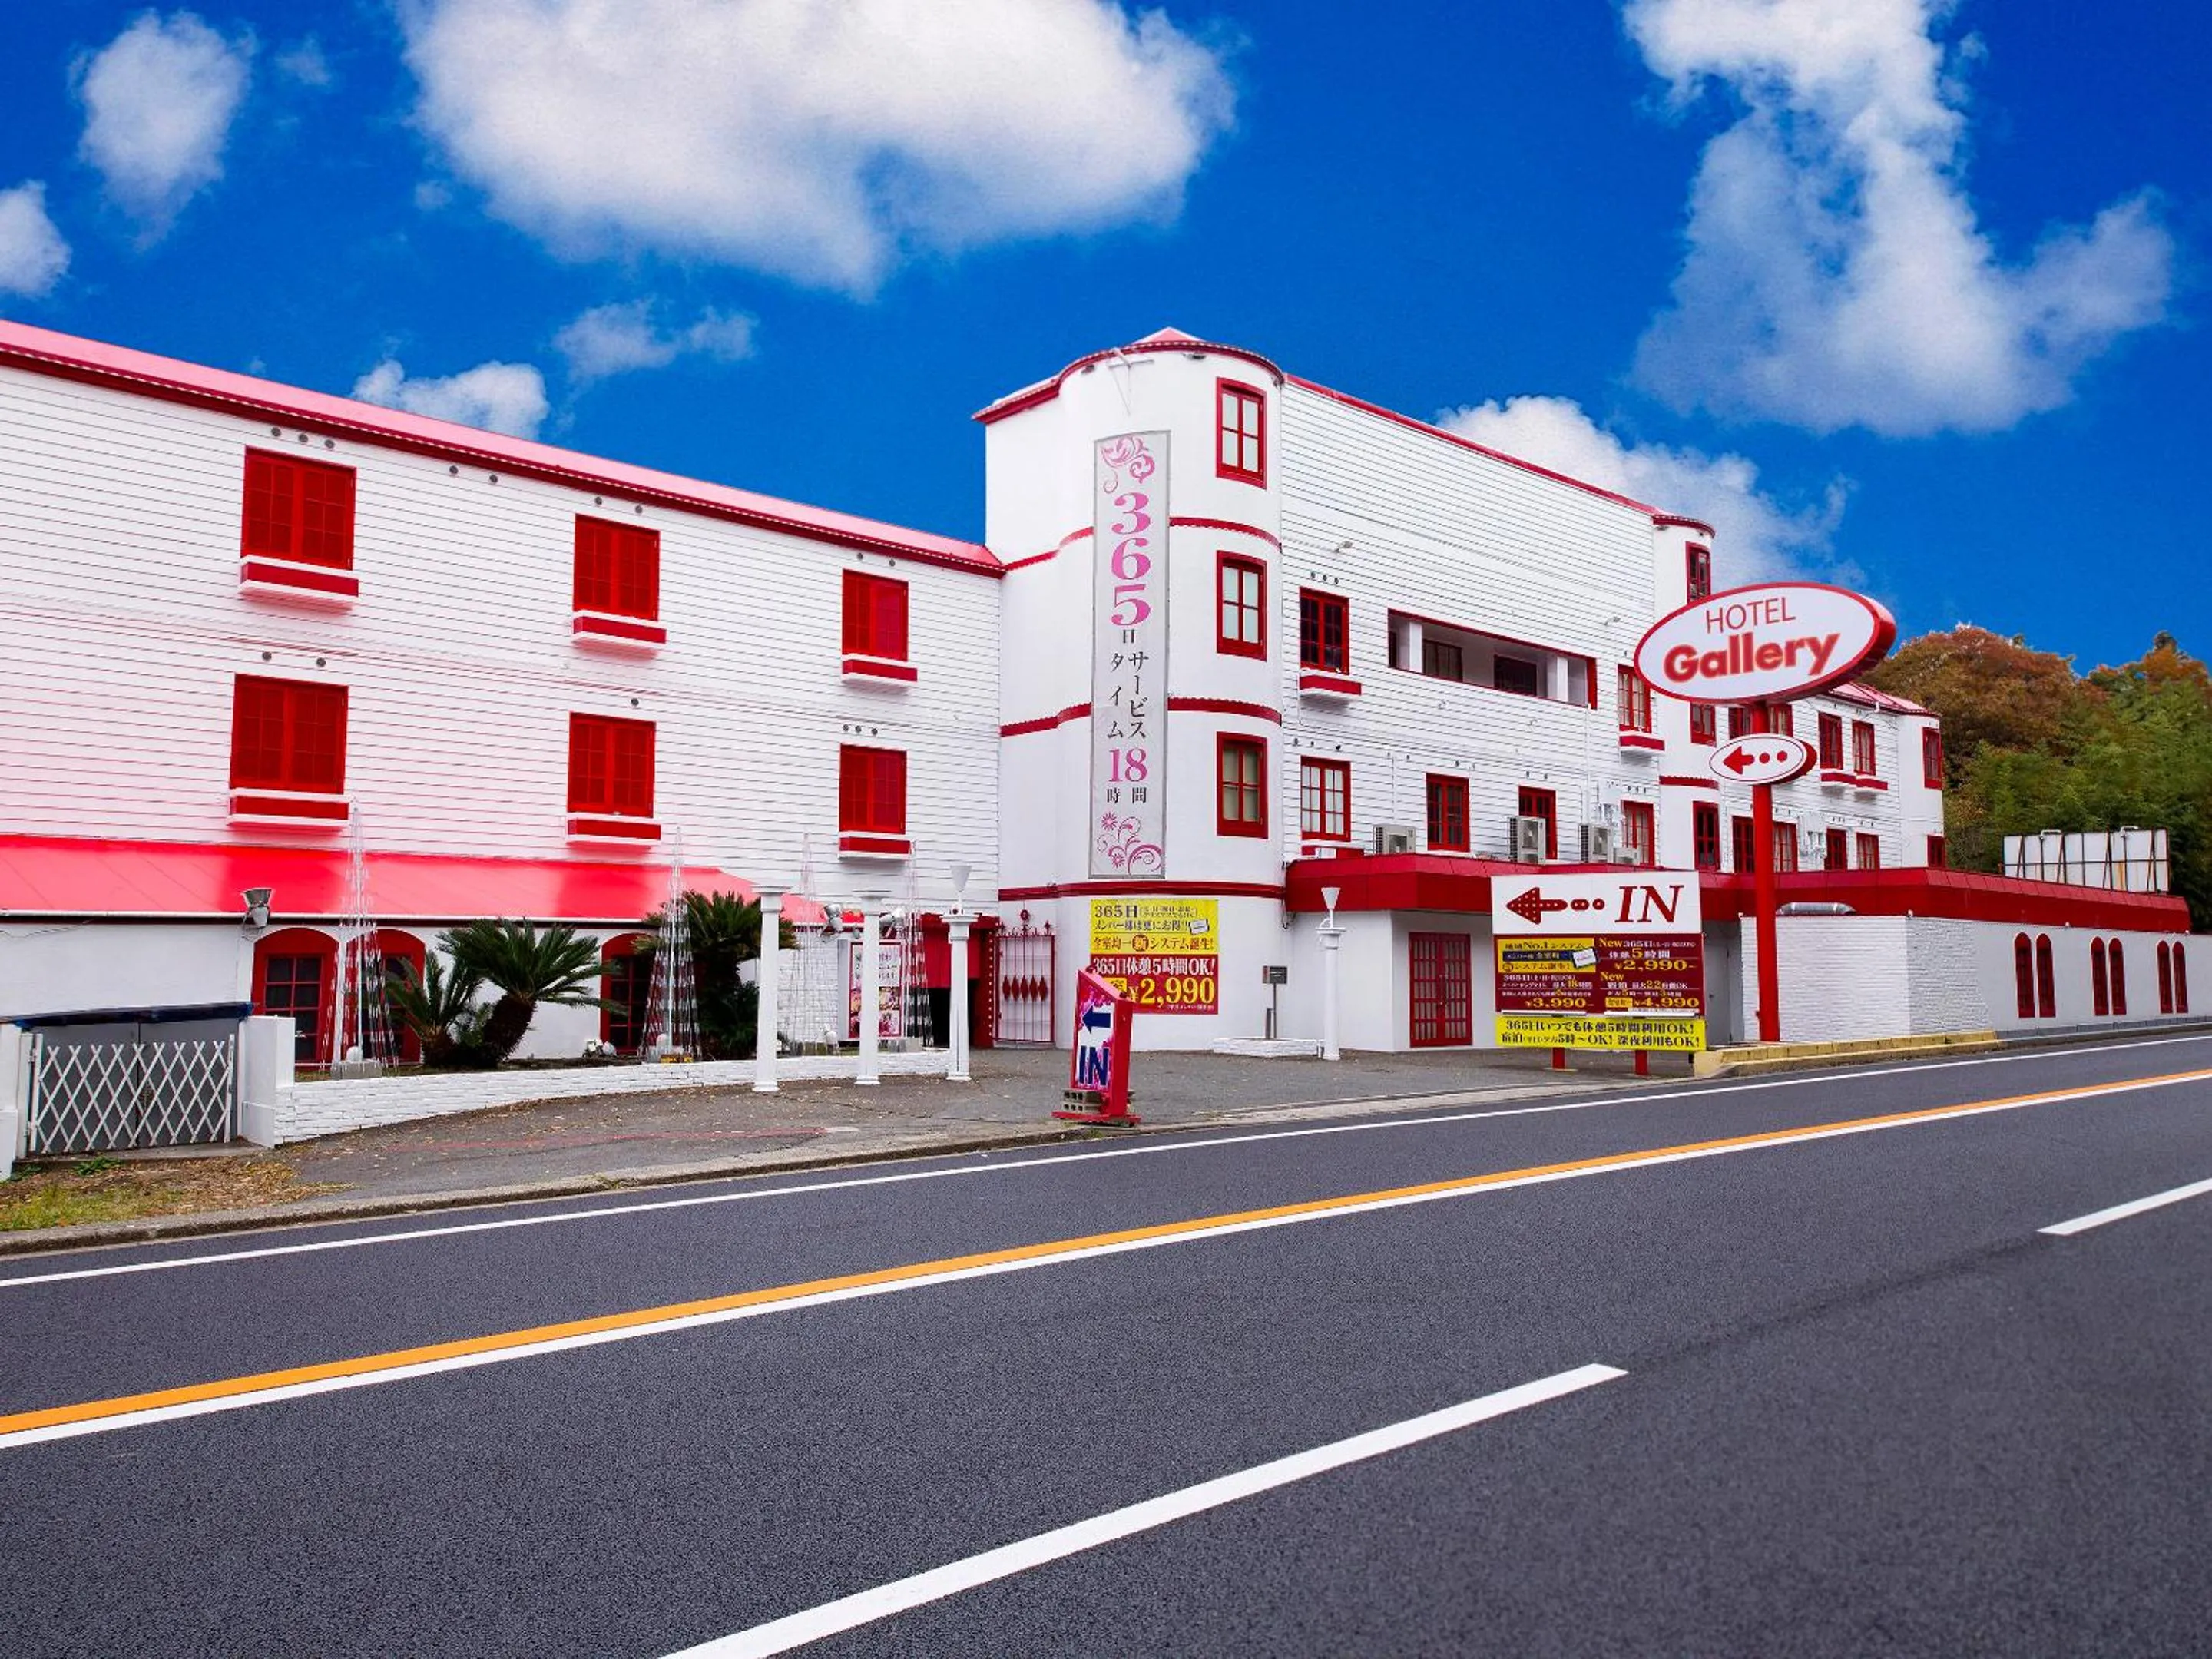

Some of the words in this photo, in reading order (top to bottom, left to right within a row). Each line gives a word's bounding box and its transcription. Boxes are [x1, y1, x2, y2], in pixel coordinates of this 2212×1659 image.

[1706, 597, 1796, 634] HOTEL
[1664, 631, 1841, 684] Gallery
[1108, 652, 1124, 739] タイム
[1128, 651, 1149, 739] サービス
[1108, 747, 1149, 783] 18
[1106, 786, 1147, 804] 時間
[1614, 884, 1684, 923] IN
[1599, 938, 1624, 948] New
[1600, 971, 1624, 982] New
[1078, 1045, 1110, 1086] IN
